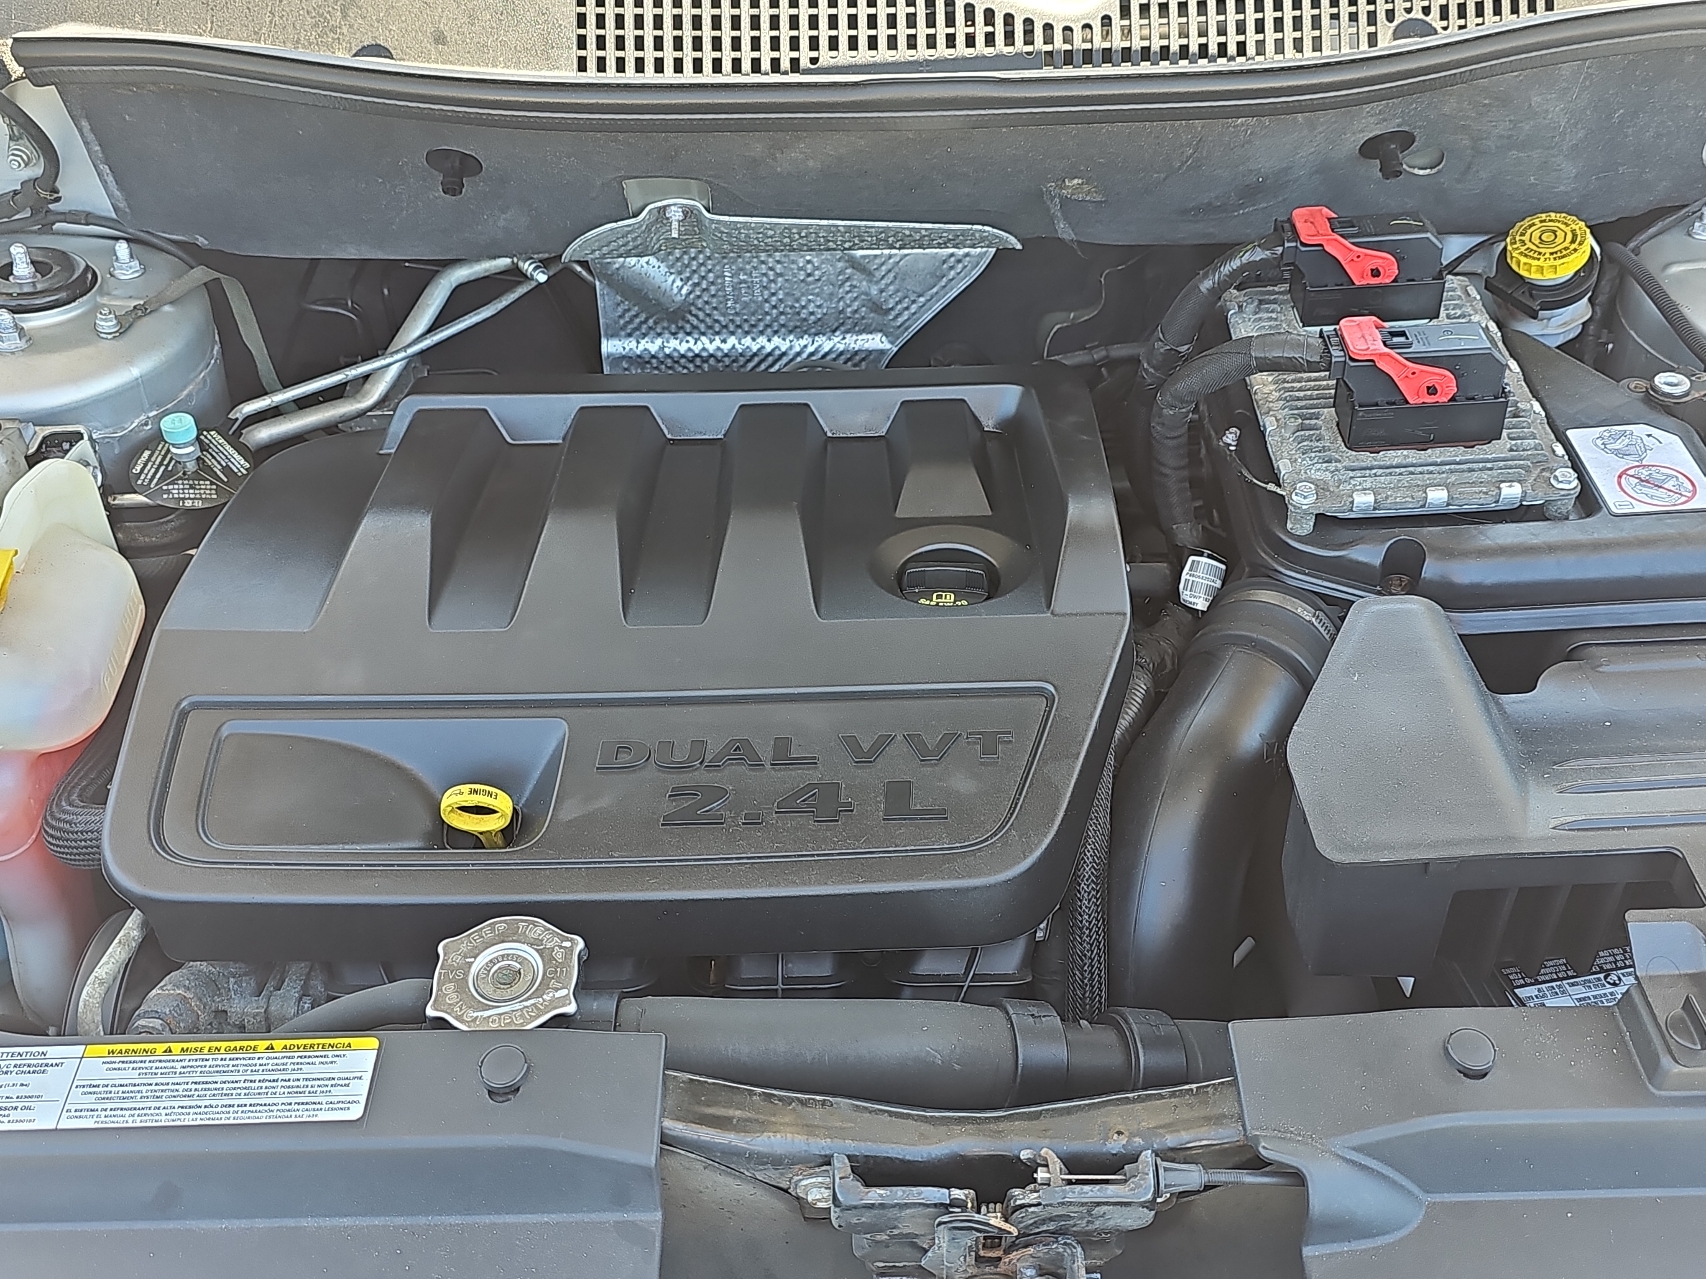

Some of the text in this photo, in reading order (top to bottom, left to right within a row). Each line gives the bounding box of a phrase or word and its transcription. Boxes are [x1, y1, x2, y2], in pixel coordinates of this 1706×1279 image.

[103, 589, 139, 693] FULL HOT
[595, 730, 1014, 771] DUAL VVT
[467, 787, 498, 800] ENGINE
[463, 922, 561, 949] KEEP TIGHT
[440, 969, 465, 979] TVS
[546, 967, 567, 977] C11
[1534, 992, 1549, 1000] OPEN
[442, 983, 460, 1004] DO
[454, 1004, 487, 1025] NOT
[489, 1006, 539, 1027] OPEN
[537, 979, 563, 1010] HOT
[0, 1050, 48, 1058] TTENTION
[106, 1047, 157, 1055] WARNING
[223, 1044, 259, 1052] GARDE
[281, 1042, 352, 1050] ADVERTENCIA
